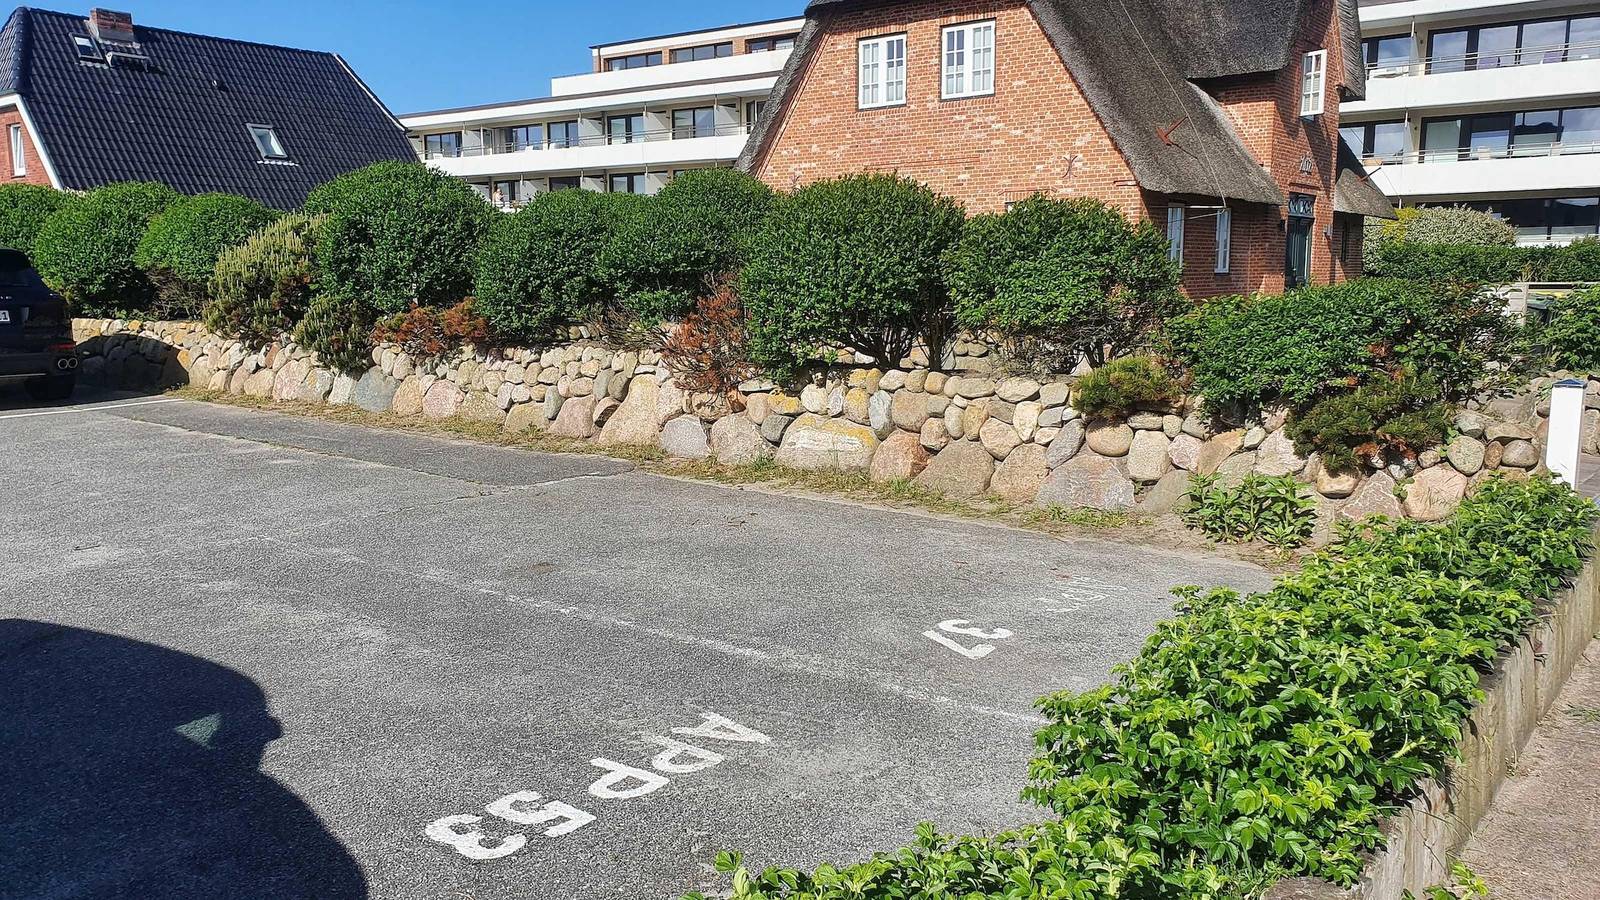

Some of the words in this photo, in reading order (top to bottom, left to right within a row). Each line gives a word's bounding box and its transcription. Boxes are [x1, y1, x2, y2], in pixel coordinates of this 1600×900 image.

[921, 618, 1013, 660] 37
[588, 711, 771, 799] APP
[424, 790, 597, 860] 53
